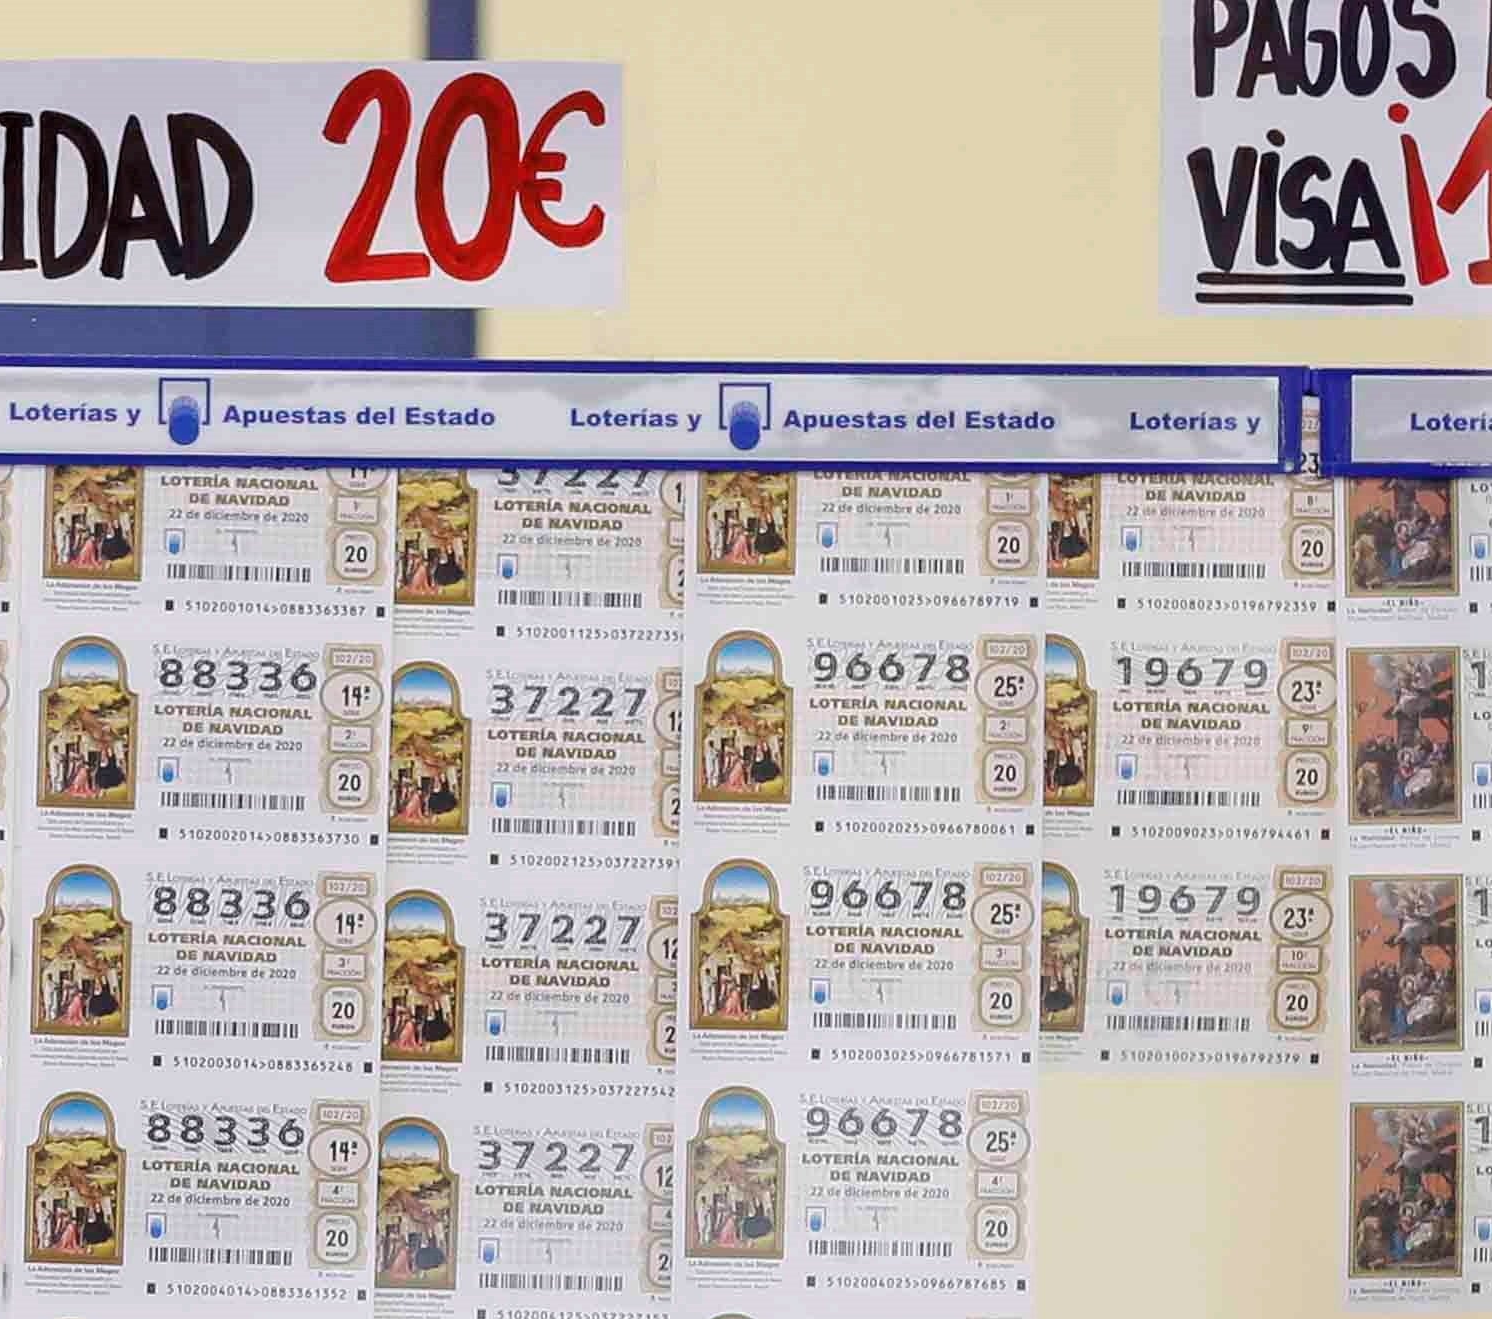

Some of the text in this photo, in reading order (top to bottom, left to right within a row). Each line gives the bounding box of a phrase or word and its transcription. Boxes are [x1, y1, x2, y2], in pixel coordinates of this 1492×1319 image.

[323, 68, 606, 283] 20€
[570, 407, 1056, 433] Loterías y Apuestas del Estado
[158, 656, 317, 694] 88336
[812, 651, 972, 687] 96678
[1114, 655, 1271, 690] 19679
[490, 683, 649, 719] 37227
